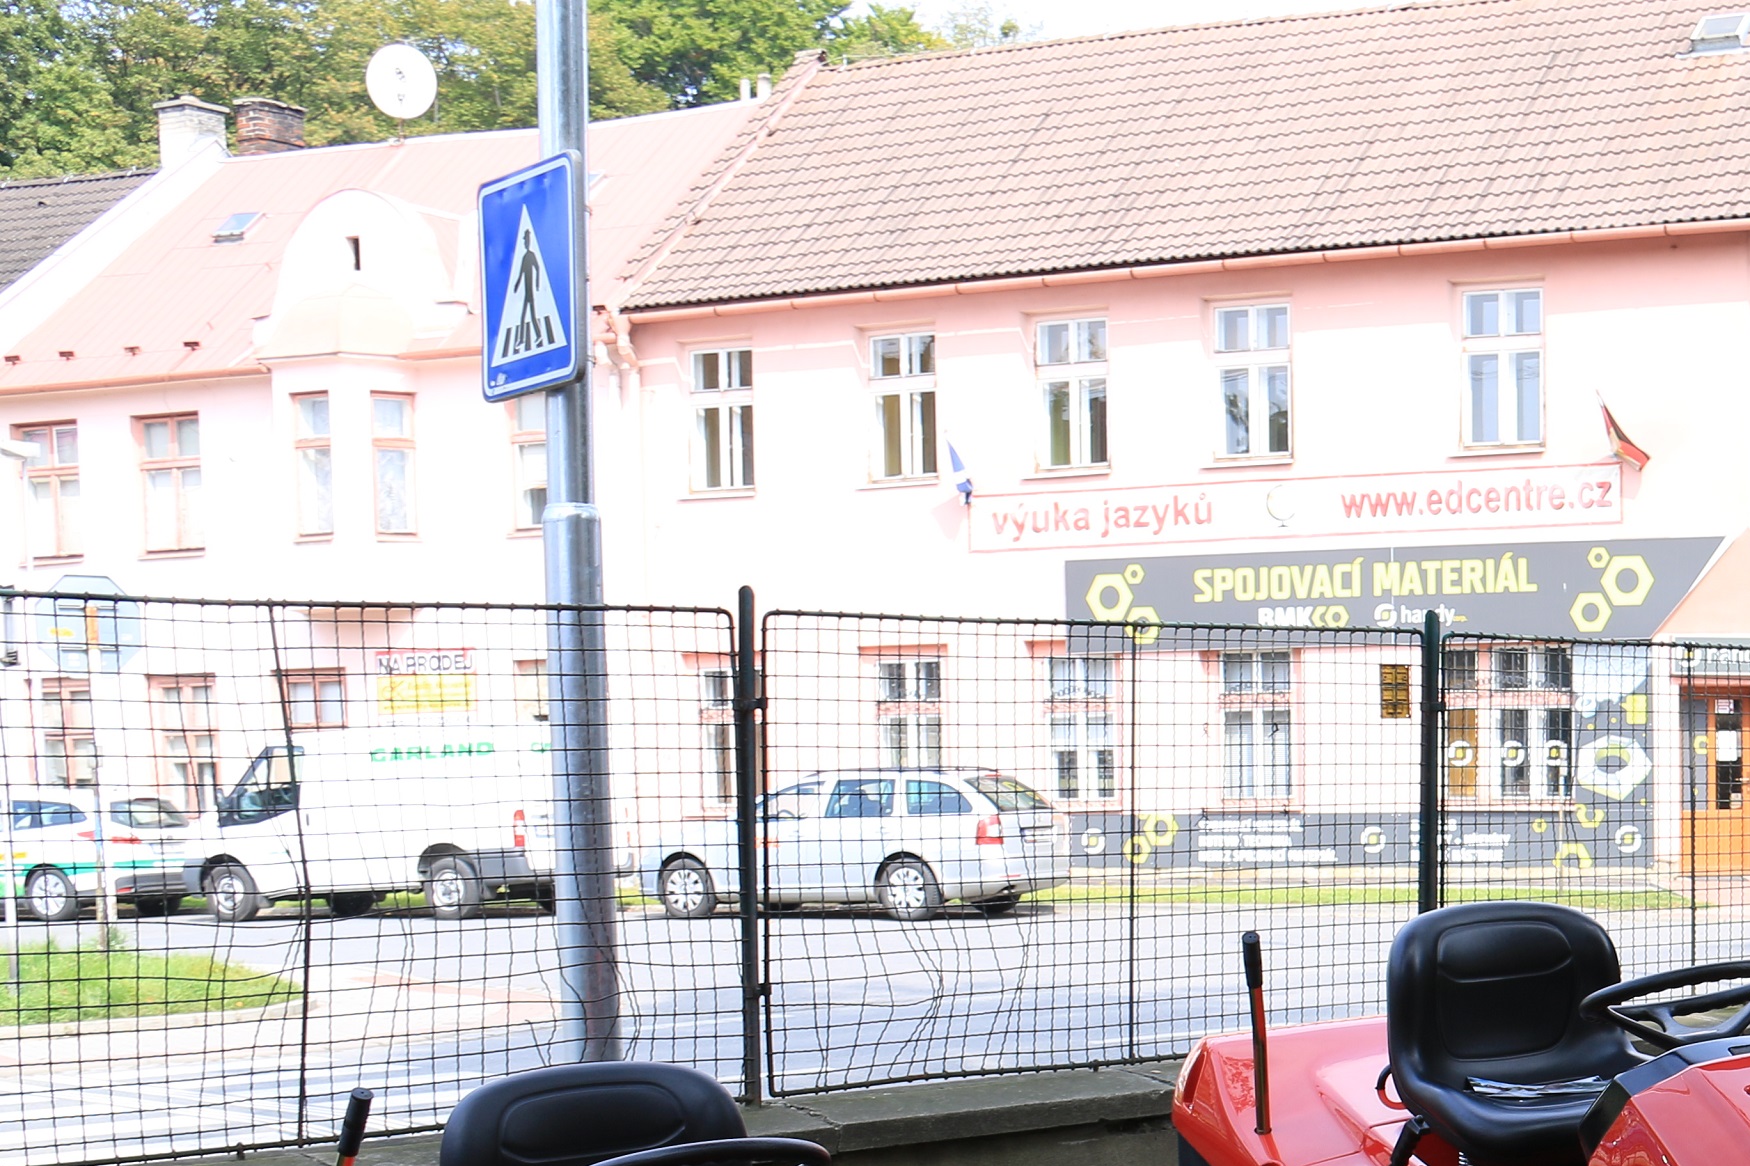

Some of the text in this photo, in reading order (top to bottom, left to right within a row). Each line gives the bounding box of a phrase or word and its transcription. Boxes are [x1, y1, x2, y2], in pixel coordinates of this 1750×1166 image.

[992, 479, 1613, 542] výuka jazyků www.edcentre.cz
[1193, 552, 1538, 602] SPOJOVACÍ MATERIÁL
[371, 741, 495, 762] GARLAND
